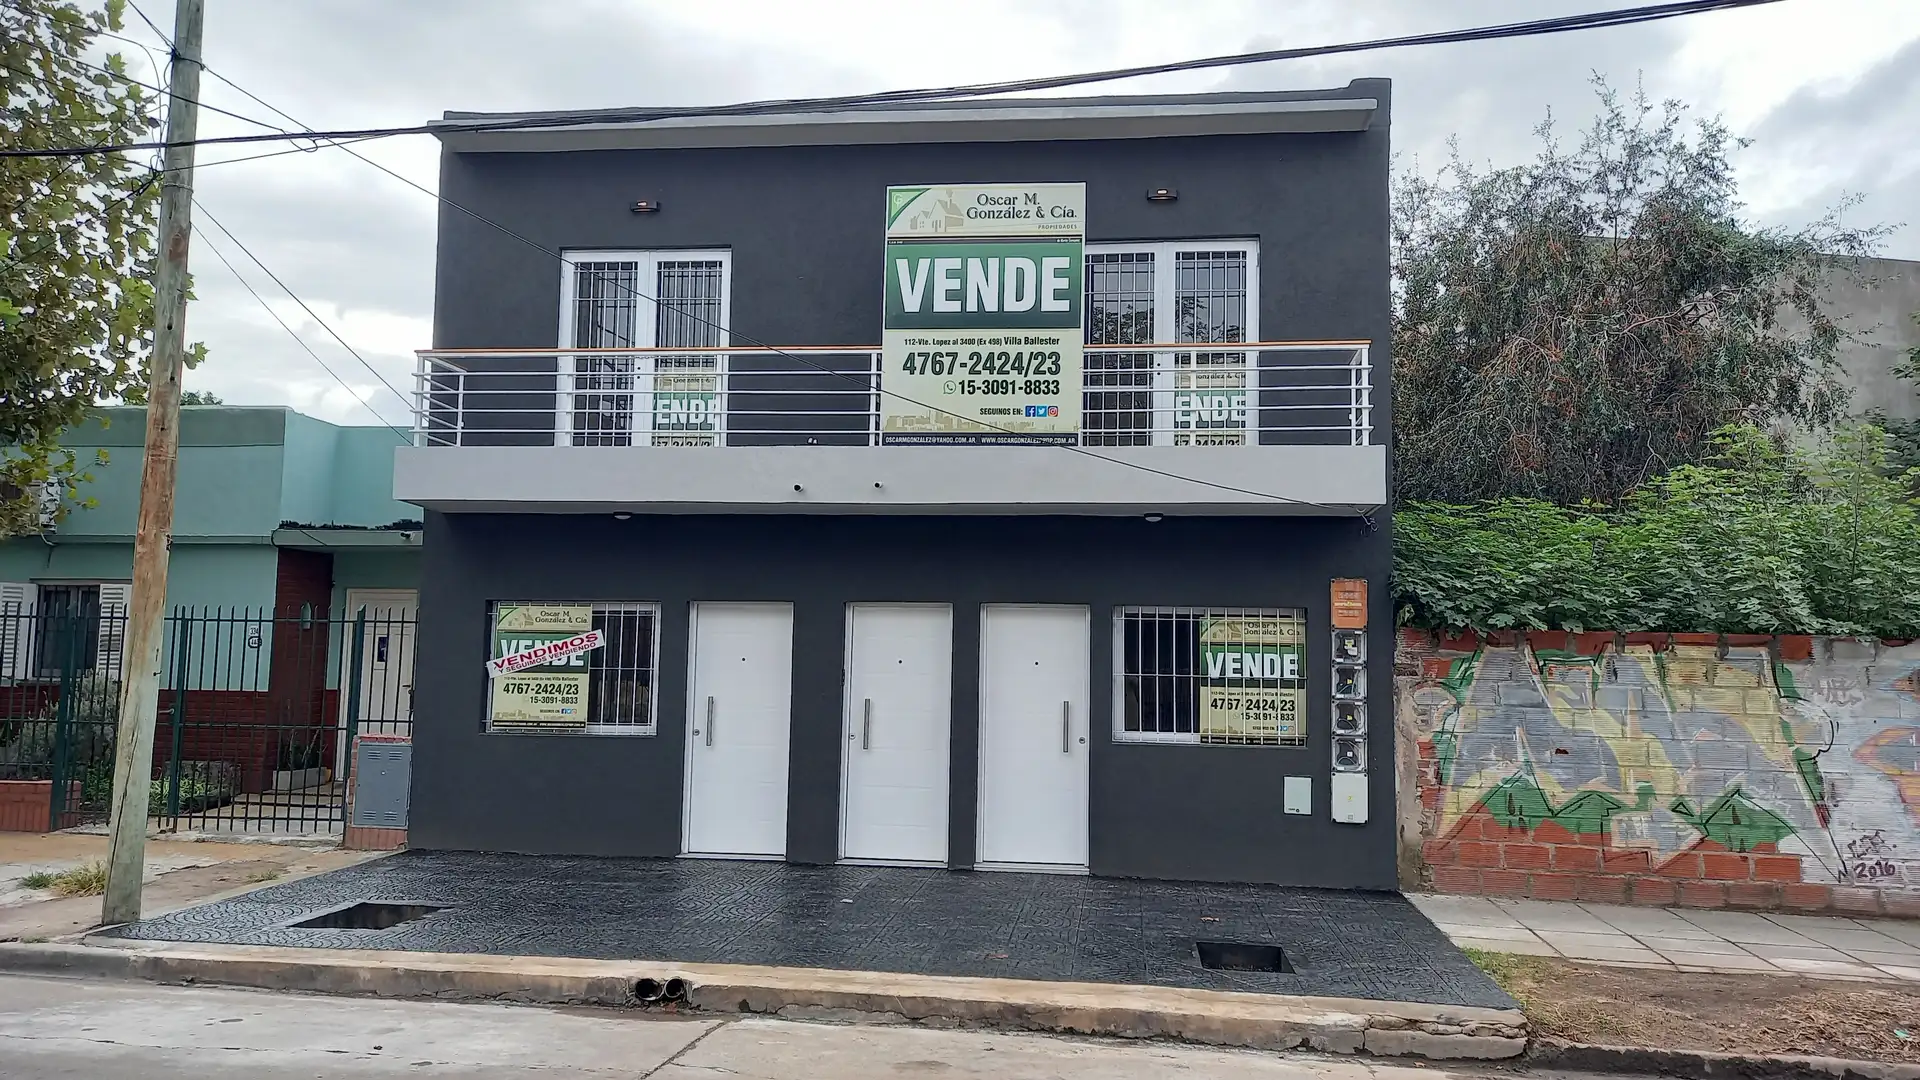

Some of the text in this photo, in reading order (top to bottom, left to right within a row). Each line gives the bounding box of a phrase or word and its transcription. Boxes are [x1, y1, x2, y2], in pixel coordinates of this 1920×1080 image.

[977, 192, 1040, 206] Oscar M.
[966, 205, 1077, 219] González & Cía.
[895, 256, 1071, 313] VENDE
[904, 338, 931, 346] 112-Vte.
[932, 338, 951, 347] Lopez
[952, 338, 959, 346] al
[960, 338, 976, 346] 3400
[976, 337, 987, 347] (Ex
[1004, 337, 1022, 345] Villa
[1024, 337, 1060, 346] Ballester
[902, 351, 1061, 377] 4767-2424/23
[958, 379, 1060, 395] 15-3091-8833
[979, 407, 1023, 416] SEGUINOS EN:
[1175, 396, 1246, 421] ENDE
[535, 616, 566, 624] González
[493, 633, 598, 669] VENDIMOS
[506, 656, 548, 672] SEGUIMOS
[549, 641, 597, 659] VENDIENDO
[1205, 652, 1299, 678] VENDE
[503, 683, 579, 696] 4767-2424/23
[530, 696, 578, 704] 15-3091-8833
